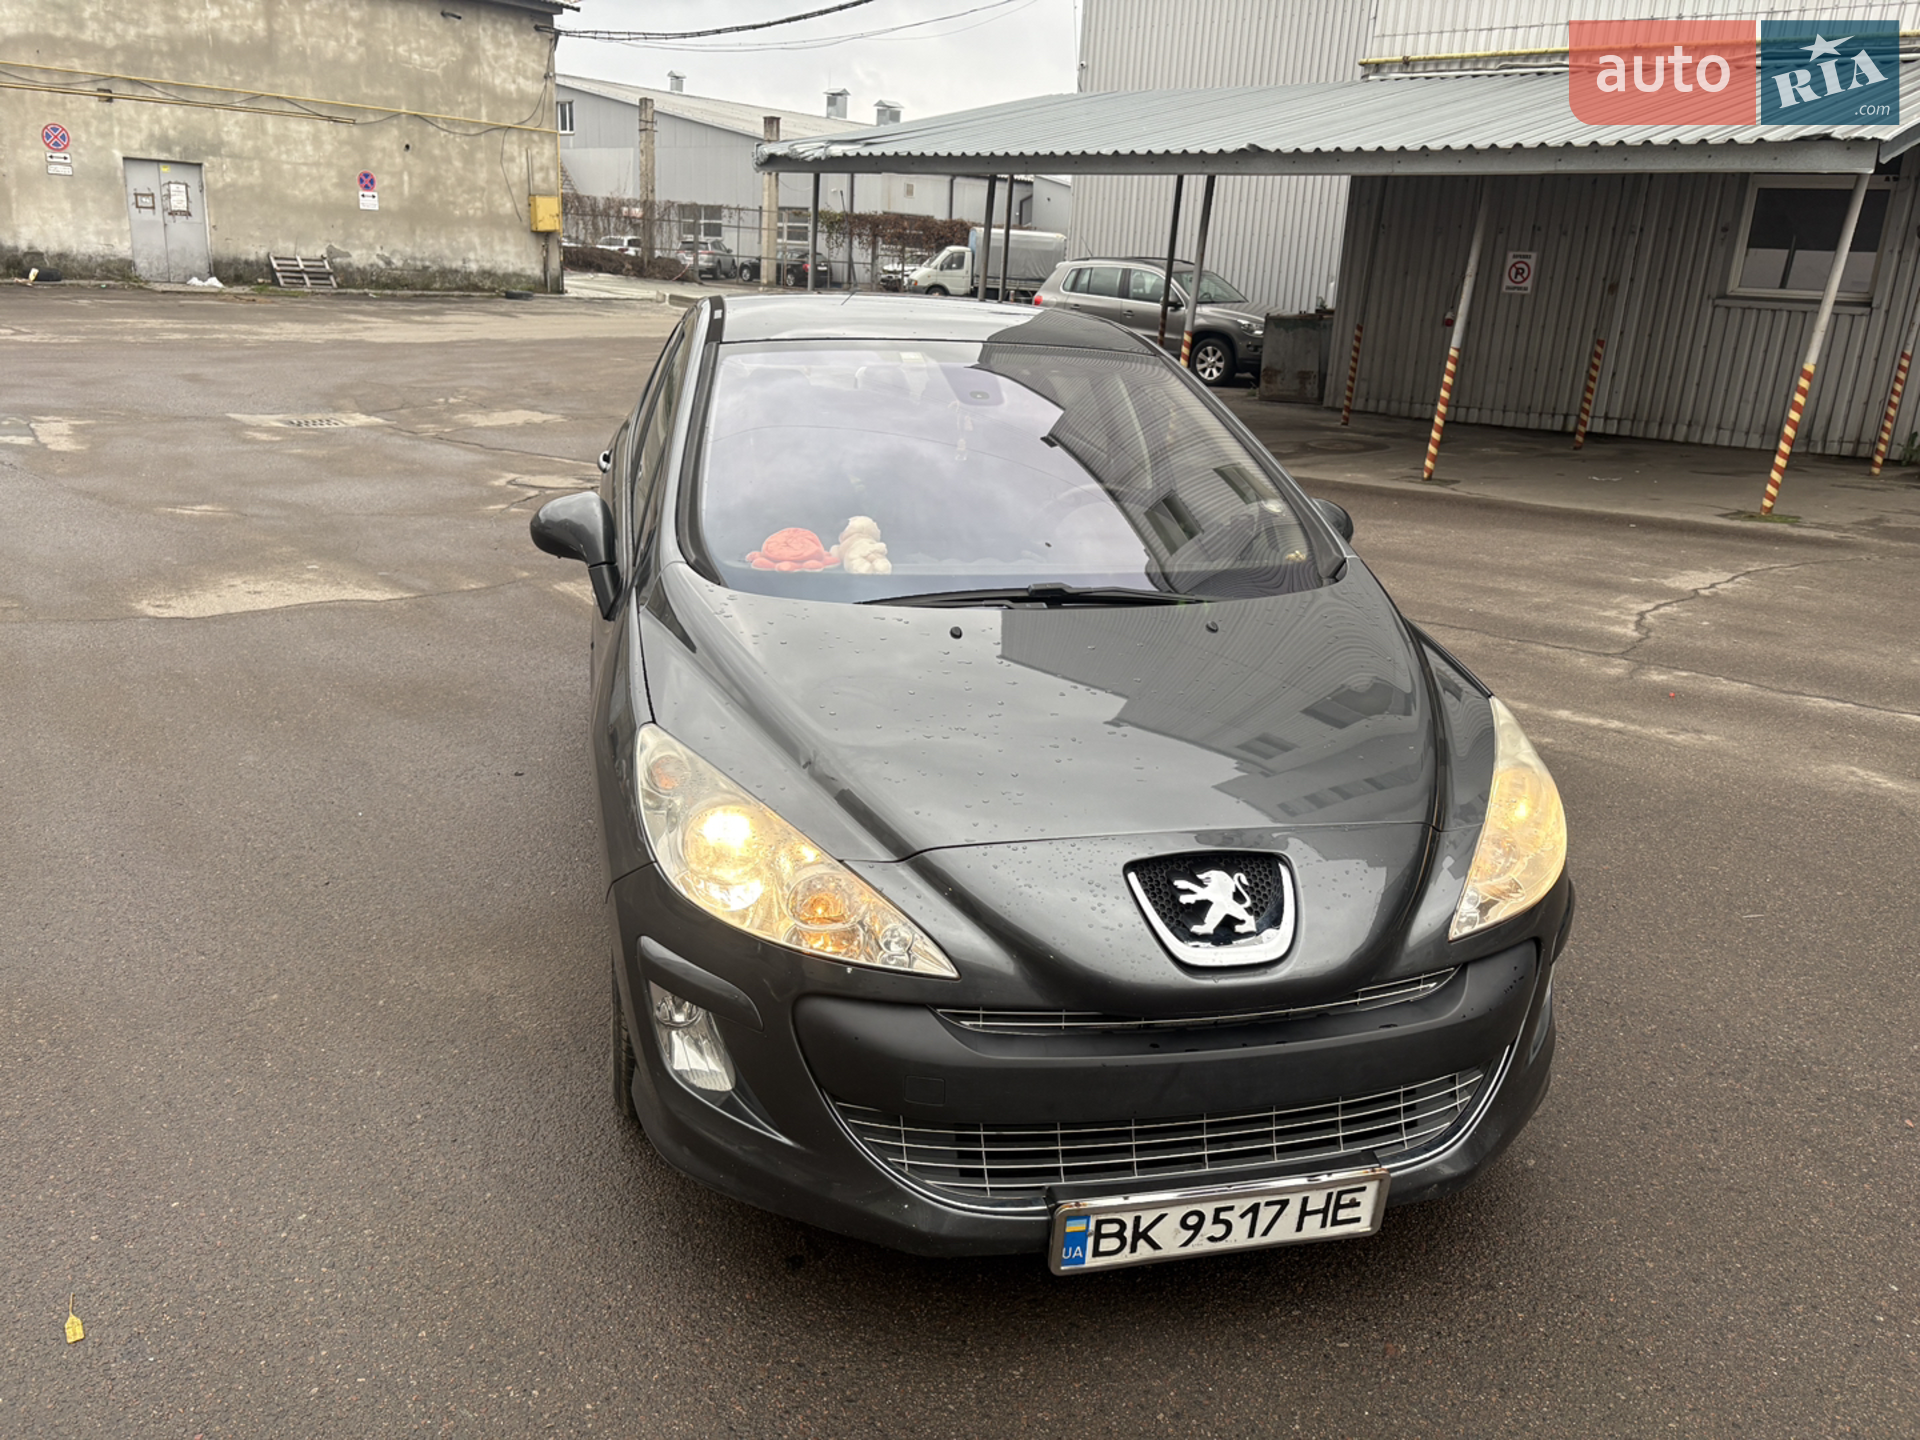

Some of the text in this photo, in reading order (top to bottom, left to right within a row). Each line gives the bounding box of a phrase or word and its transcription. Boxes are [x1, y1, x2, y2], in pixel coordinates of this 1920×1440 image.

[1092, 1186, 1367, 1258] BK 9517 HE
[1062, 1245, 1083, 1260] UA
